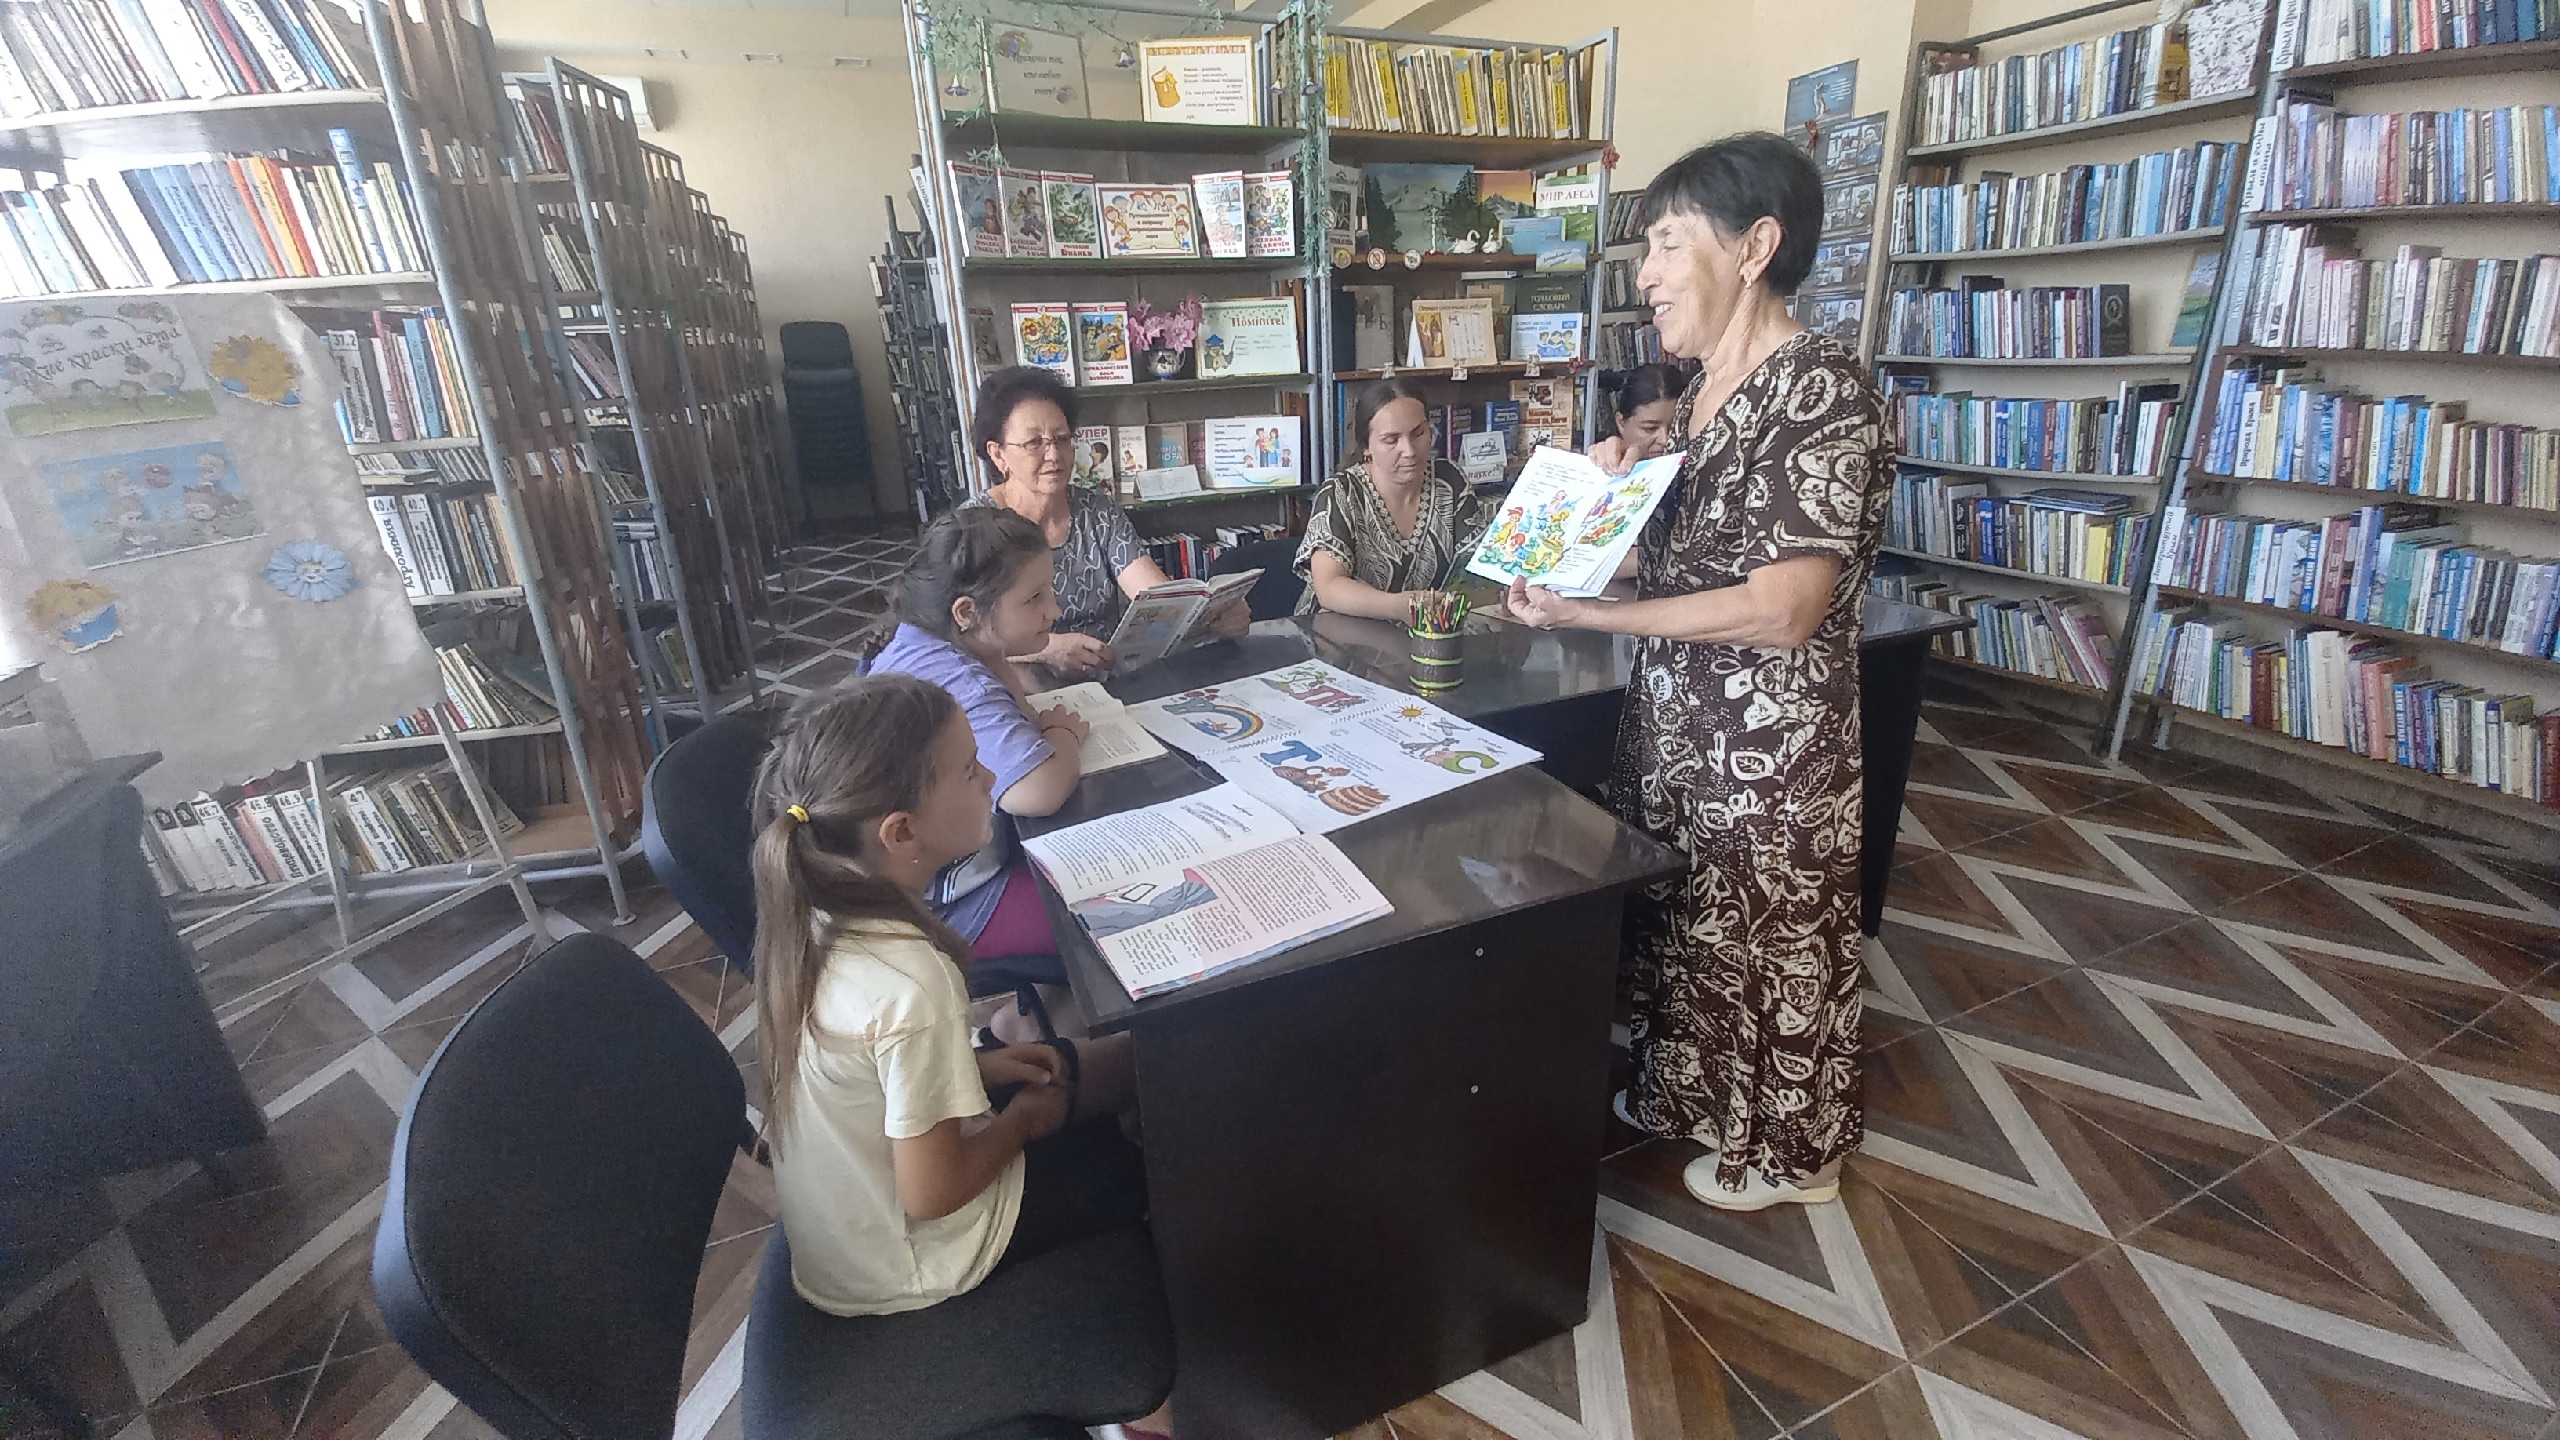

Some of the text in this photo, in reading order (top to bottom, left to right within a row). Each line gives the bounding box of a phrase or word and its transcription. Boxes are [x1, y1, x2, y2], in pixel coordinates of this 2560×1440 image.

[2241, 169, 2257, 208] Крым
[136, 327, 182, 349] лета
[1075, 428, 1108, 438] УПЕР
